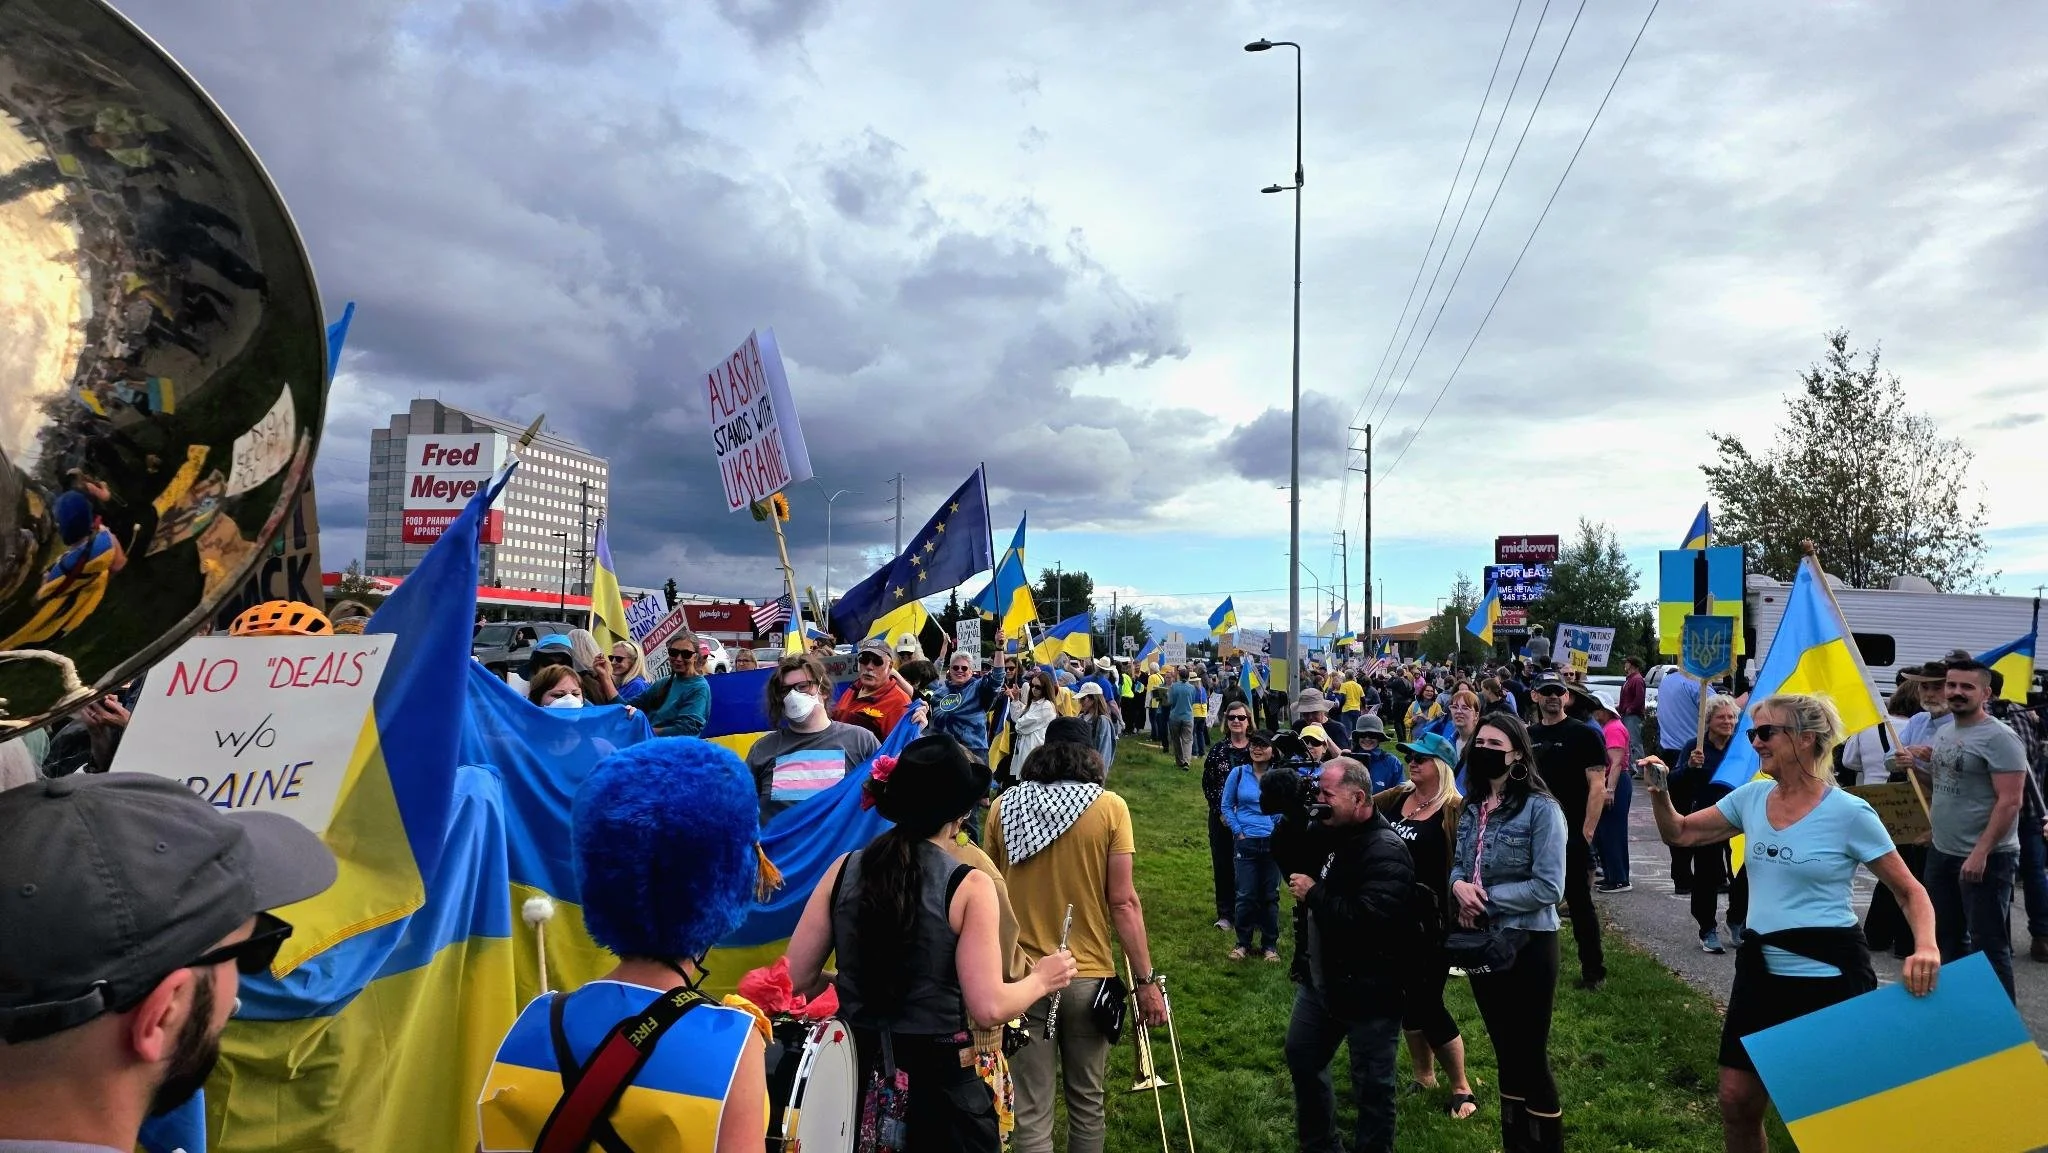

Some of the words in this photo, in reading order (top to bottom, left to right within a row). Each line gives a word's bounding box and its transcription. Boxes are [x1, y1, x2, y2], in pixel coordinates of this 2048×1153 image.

[708, 337, 766, 424] ALASKA
[713, 411, 753, 457] STANDS
[750, 392, 775, 434] WITH
[421, 442, 481, 466] Fred
[721, 427, 789, 508] UKRAINE
[405, 516, 423, 526] FOOD
[1501, 538, 1556, 553] midtown
[1499, 568, 1520, 578] FOR
[643, 612, 681, 652] WARNING
[166, 657, 239, 698] NO
[266, 646, 380, 690] "DEALS"
[628, 1016, 660, 1048] FIRE
